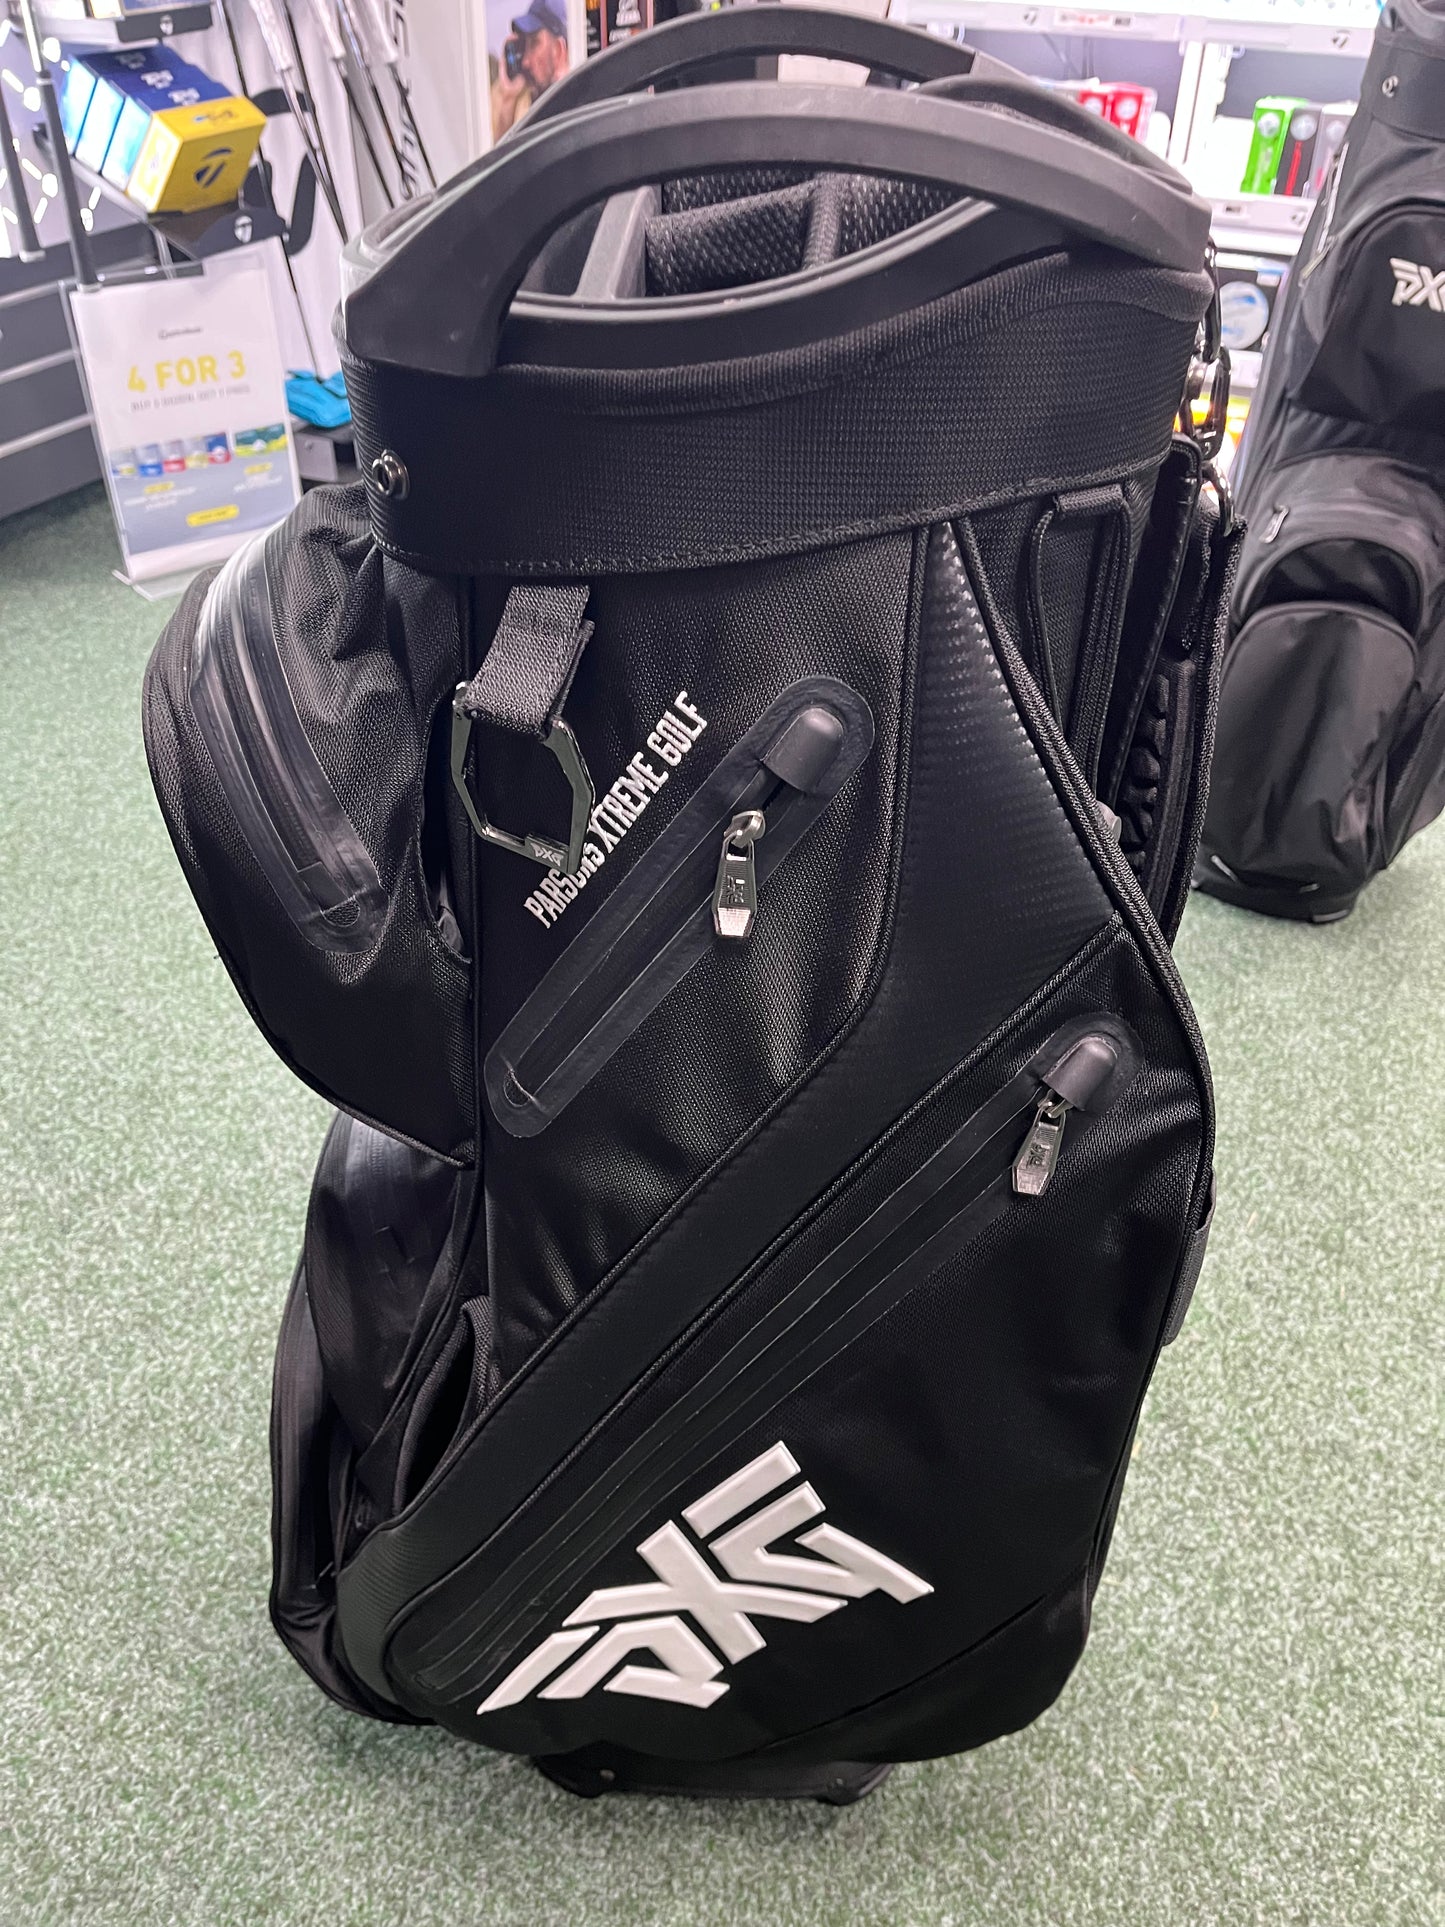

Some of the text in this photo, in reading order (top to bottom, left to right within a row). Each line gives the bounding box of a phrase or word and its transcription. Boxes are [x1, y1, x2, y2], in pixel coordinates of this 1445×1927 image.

[127, 348, 247, 393] 4 FOR 3
[585, 751, 669, 854] XTREME
[646, 690, 708, 767] GOLF
[476, 1440, 935, 1715] PXG
